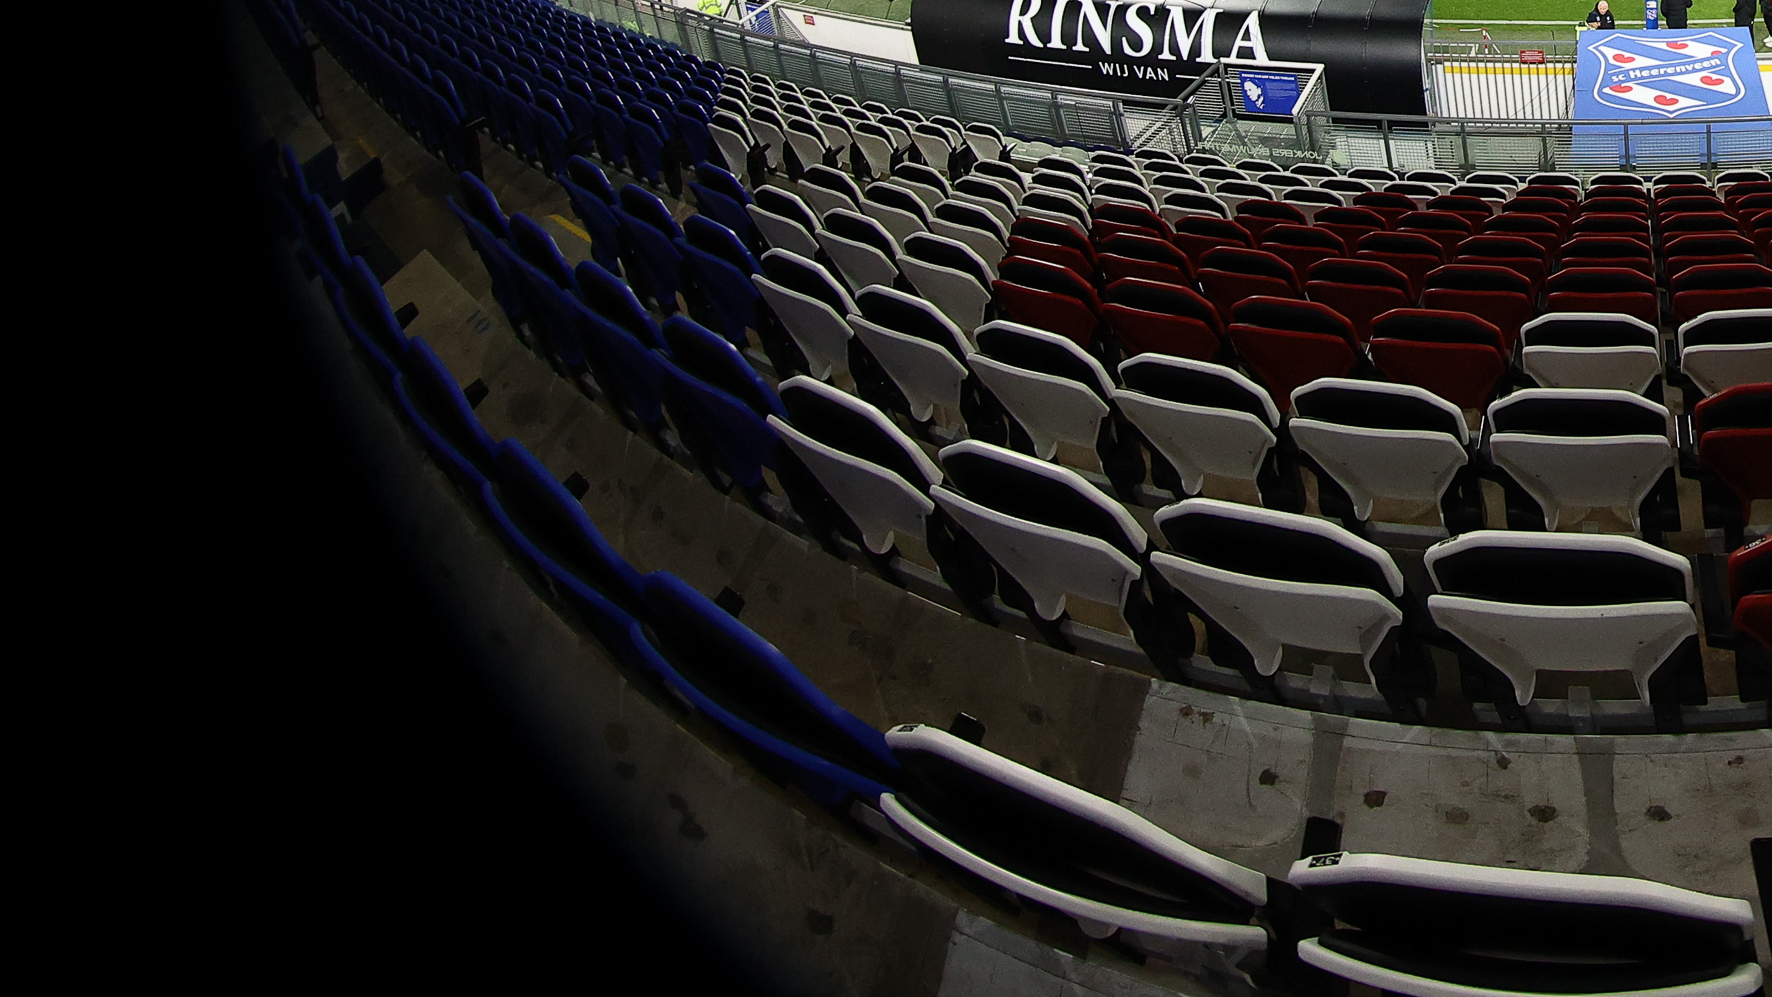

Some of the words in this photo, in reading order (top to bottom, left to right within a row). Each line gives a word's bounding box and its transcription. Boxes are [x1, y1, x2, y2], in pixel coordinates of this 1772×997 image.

[1098, 61, 1129, 77] WIJ
[1134, 64, 1170, 82] VAN
[1611, 72, 1626, 83] sc
[1629, 57, 1721, 80] Heerenveen
[1316, 855, 1336, 866] 37
